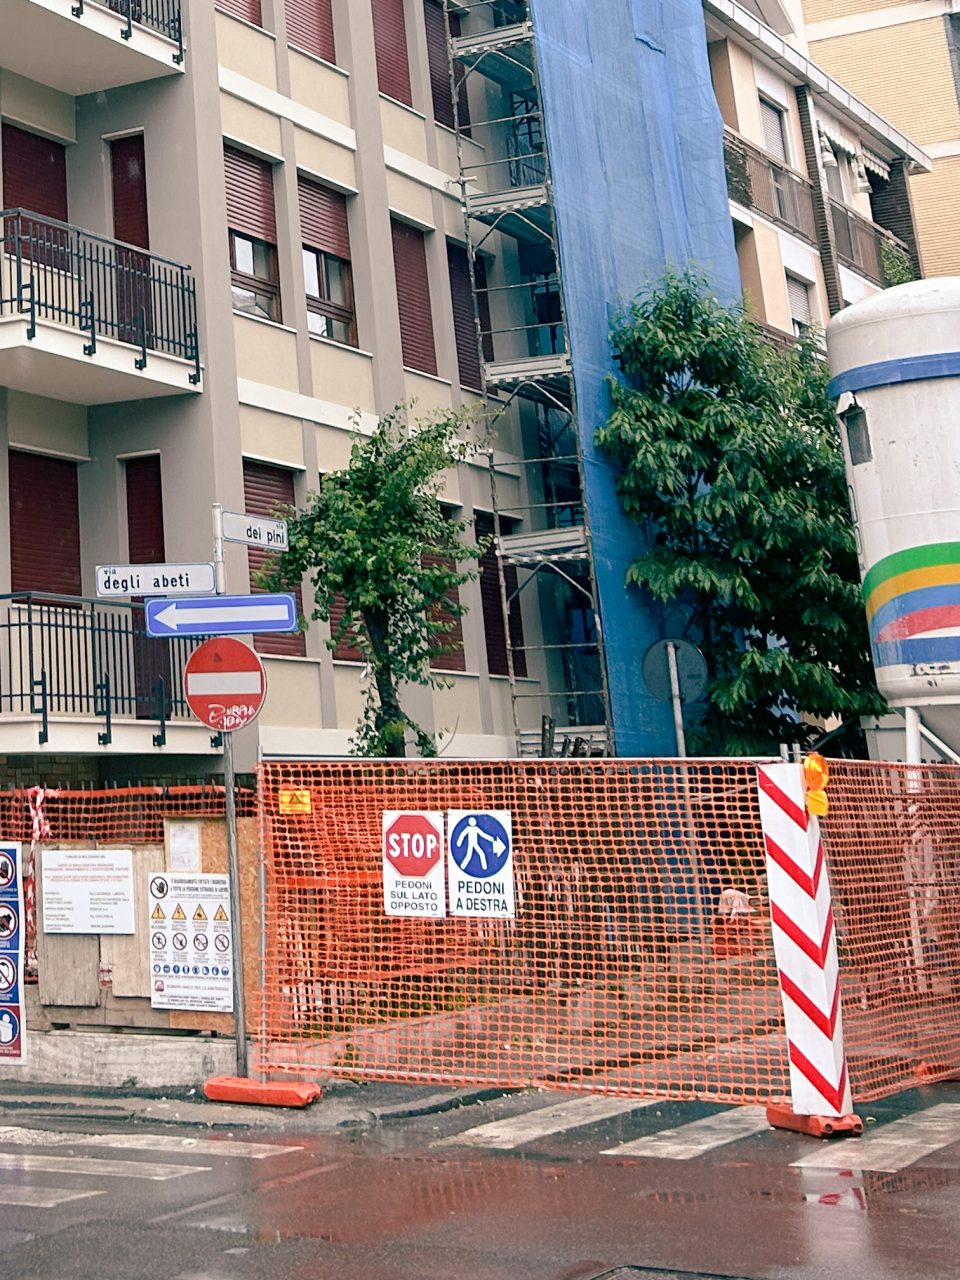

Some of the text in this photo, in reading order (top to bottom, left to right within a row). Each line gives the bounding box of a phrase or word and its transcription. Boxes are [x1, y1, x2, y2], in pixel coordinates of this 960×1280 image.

[246, 525, 285, 544] dei pini
[103, 567, 117, 575] via
[103, 572, 190, 592] degli abeti
[388, 832, 438, 859] STOP
[395, 880, 432, 890] PEDONI
[458, 881, 505, 895] PEDONI
[390, 890, 438, 901] SUL LATO
[390, 901, 438, 911] OPPOSTO
[456, 897, 508, 912] A DESTRA
